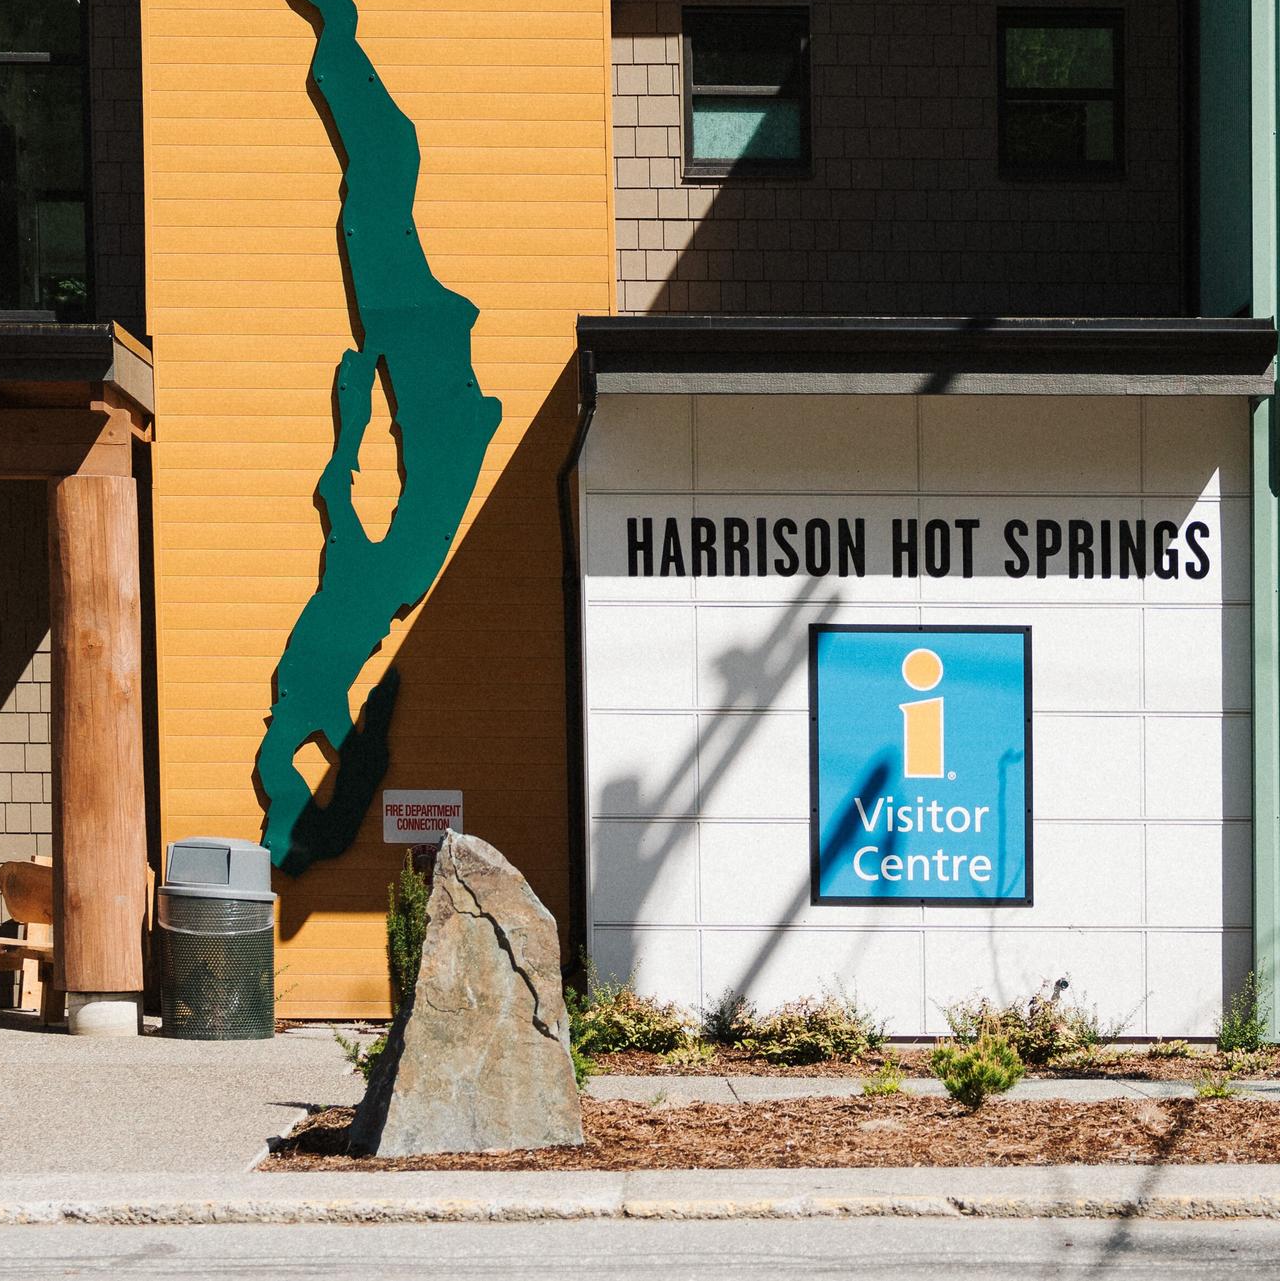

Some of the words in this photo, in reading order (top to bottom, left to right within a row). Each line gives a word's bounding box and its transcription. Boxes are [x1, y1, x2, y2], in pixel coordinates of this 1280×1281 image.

[626, 517, 866, 578] HARRISON
[892, 518, 981, 579] HOT
[1003, 519, 1211, 580] SPRINGS
[385, 804, 404, 817] FIRE
[405, 804, 462, 817] DEPARTMENT
[396, 818, 450, 831] CONNECTION
[854, 796, 990, 833] Visitor
[853, 845, 992, 882] Centre
